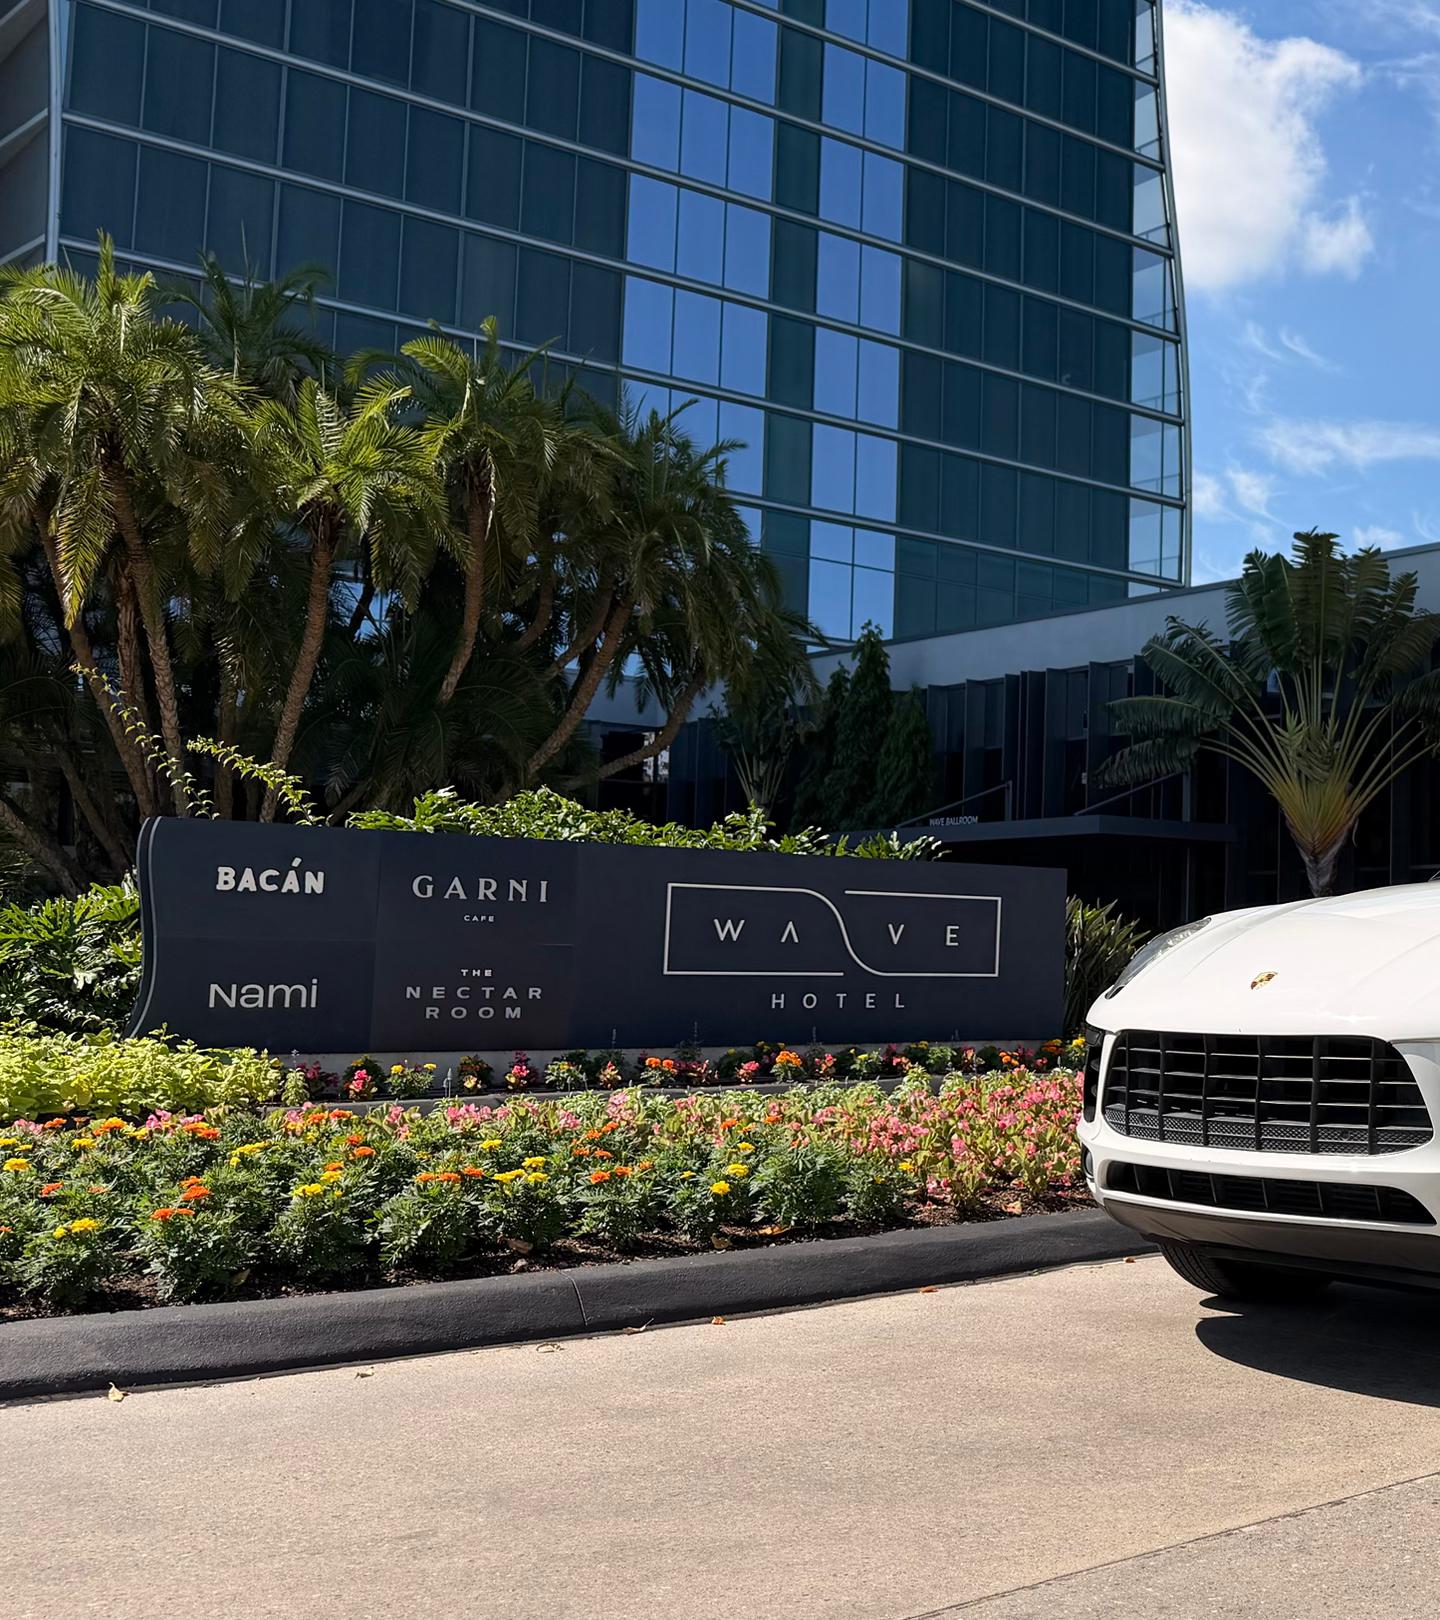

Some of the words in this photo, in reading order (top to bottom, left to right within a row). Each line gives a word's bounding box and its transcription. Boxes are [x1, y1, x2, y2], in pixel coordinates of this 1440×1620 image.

[945, 816, 978, 826] BALLROOM
[215, 857, 325, 895] BACÁN
[412, 875, 548, 902] GARNI
[463, 914, 495, 923] CAFE
[713, 918, 960, 946] WAVE
[460, 968, 492, 977] THE
[208, 978, 318, 1009] Nami
[405, 986, 542, 1000] NECTAR
[771, 993, 905, 1009] HOTEL
[425, 1006, 522, 1019] ROOM
